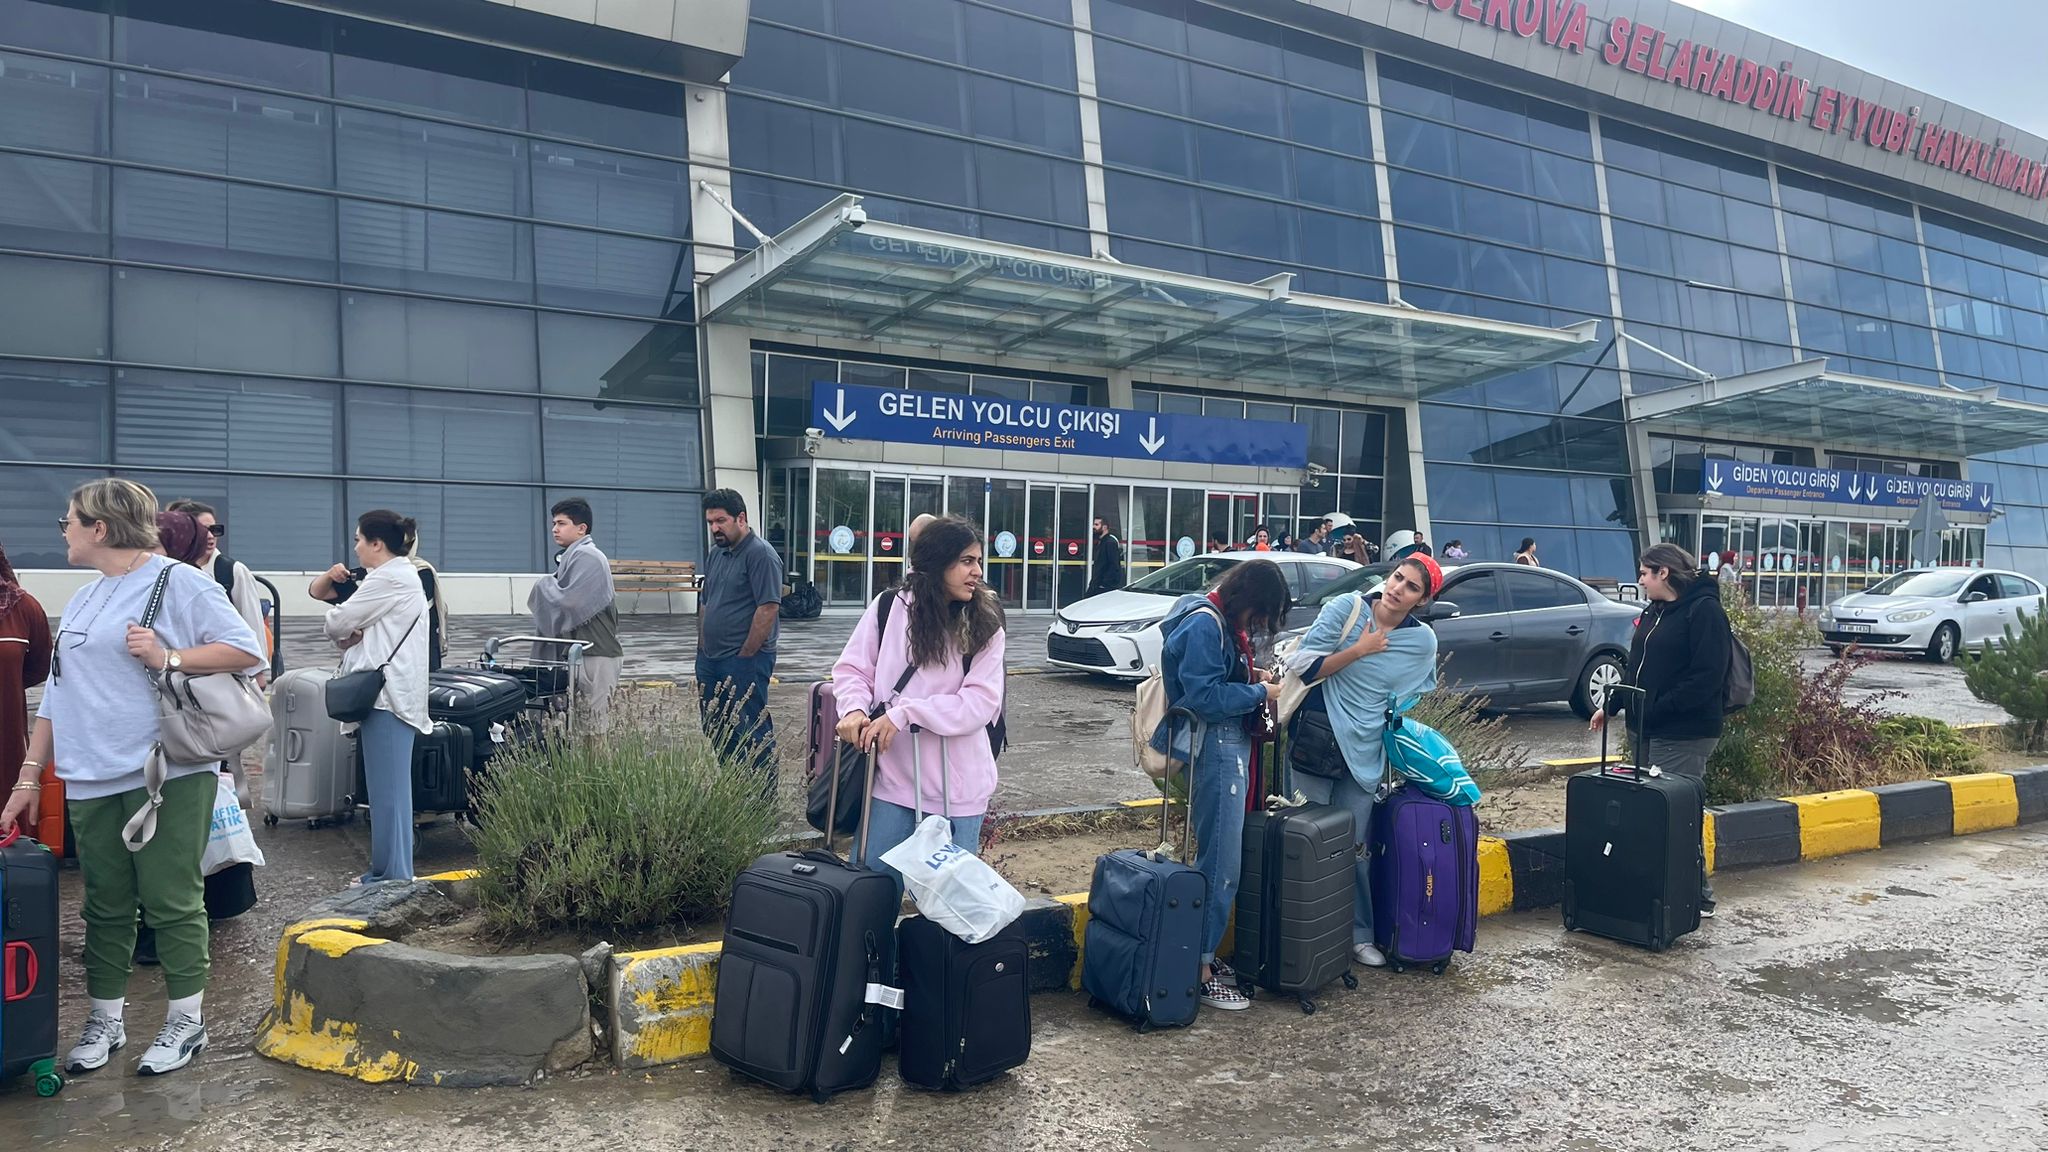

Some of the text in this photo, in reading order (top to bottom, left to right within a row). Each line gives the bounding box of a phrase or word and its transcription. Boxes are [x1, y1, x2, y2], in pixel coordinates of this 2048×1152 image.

[1603, 16, 1810, 122] SELAHADDİN
[1813, 86, 1920, 155] EYYUBİ
[878, 392, 1120, 439] GELEN YOLCU ÇIKIŞI
[932, 426, 1075, 449] Arriving Passengers Exit
[1733, 463, 1841, 492] GİDEN YOLCU GİRİŞİ
[1886, 477, 1915, 494] GİDEN
[1948, 482, 1974, 501] GİRİŞİ
[1746, 485, 1825, 498] Departure Passenger Entrance
[211, 815, 242, 832] ATIK
